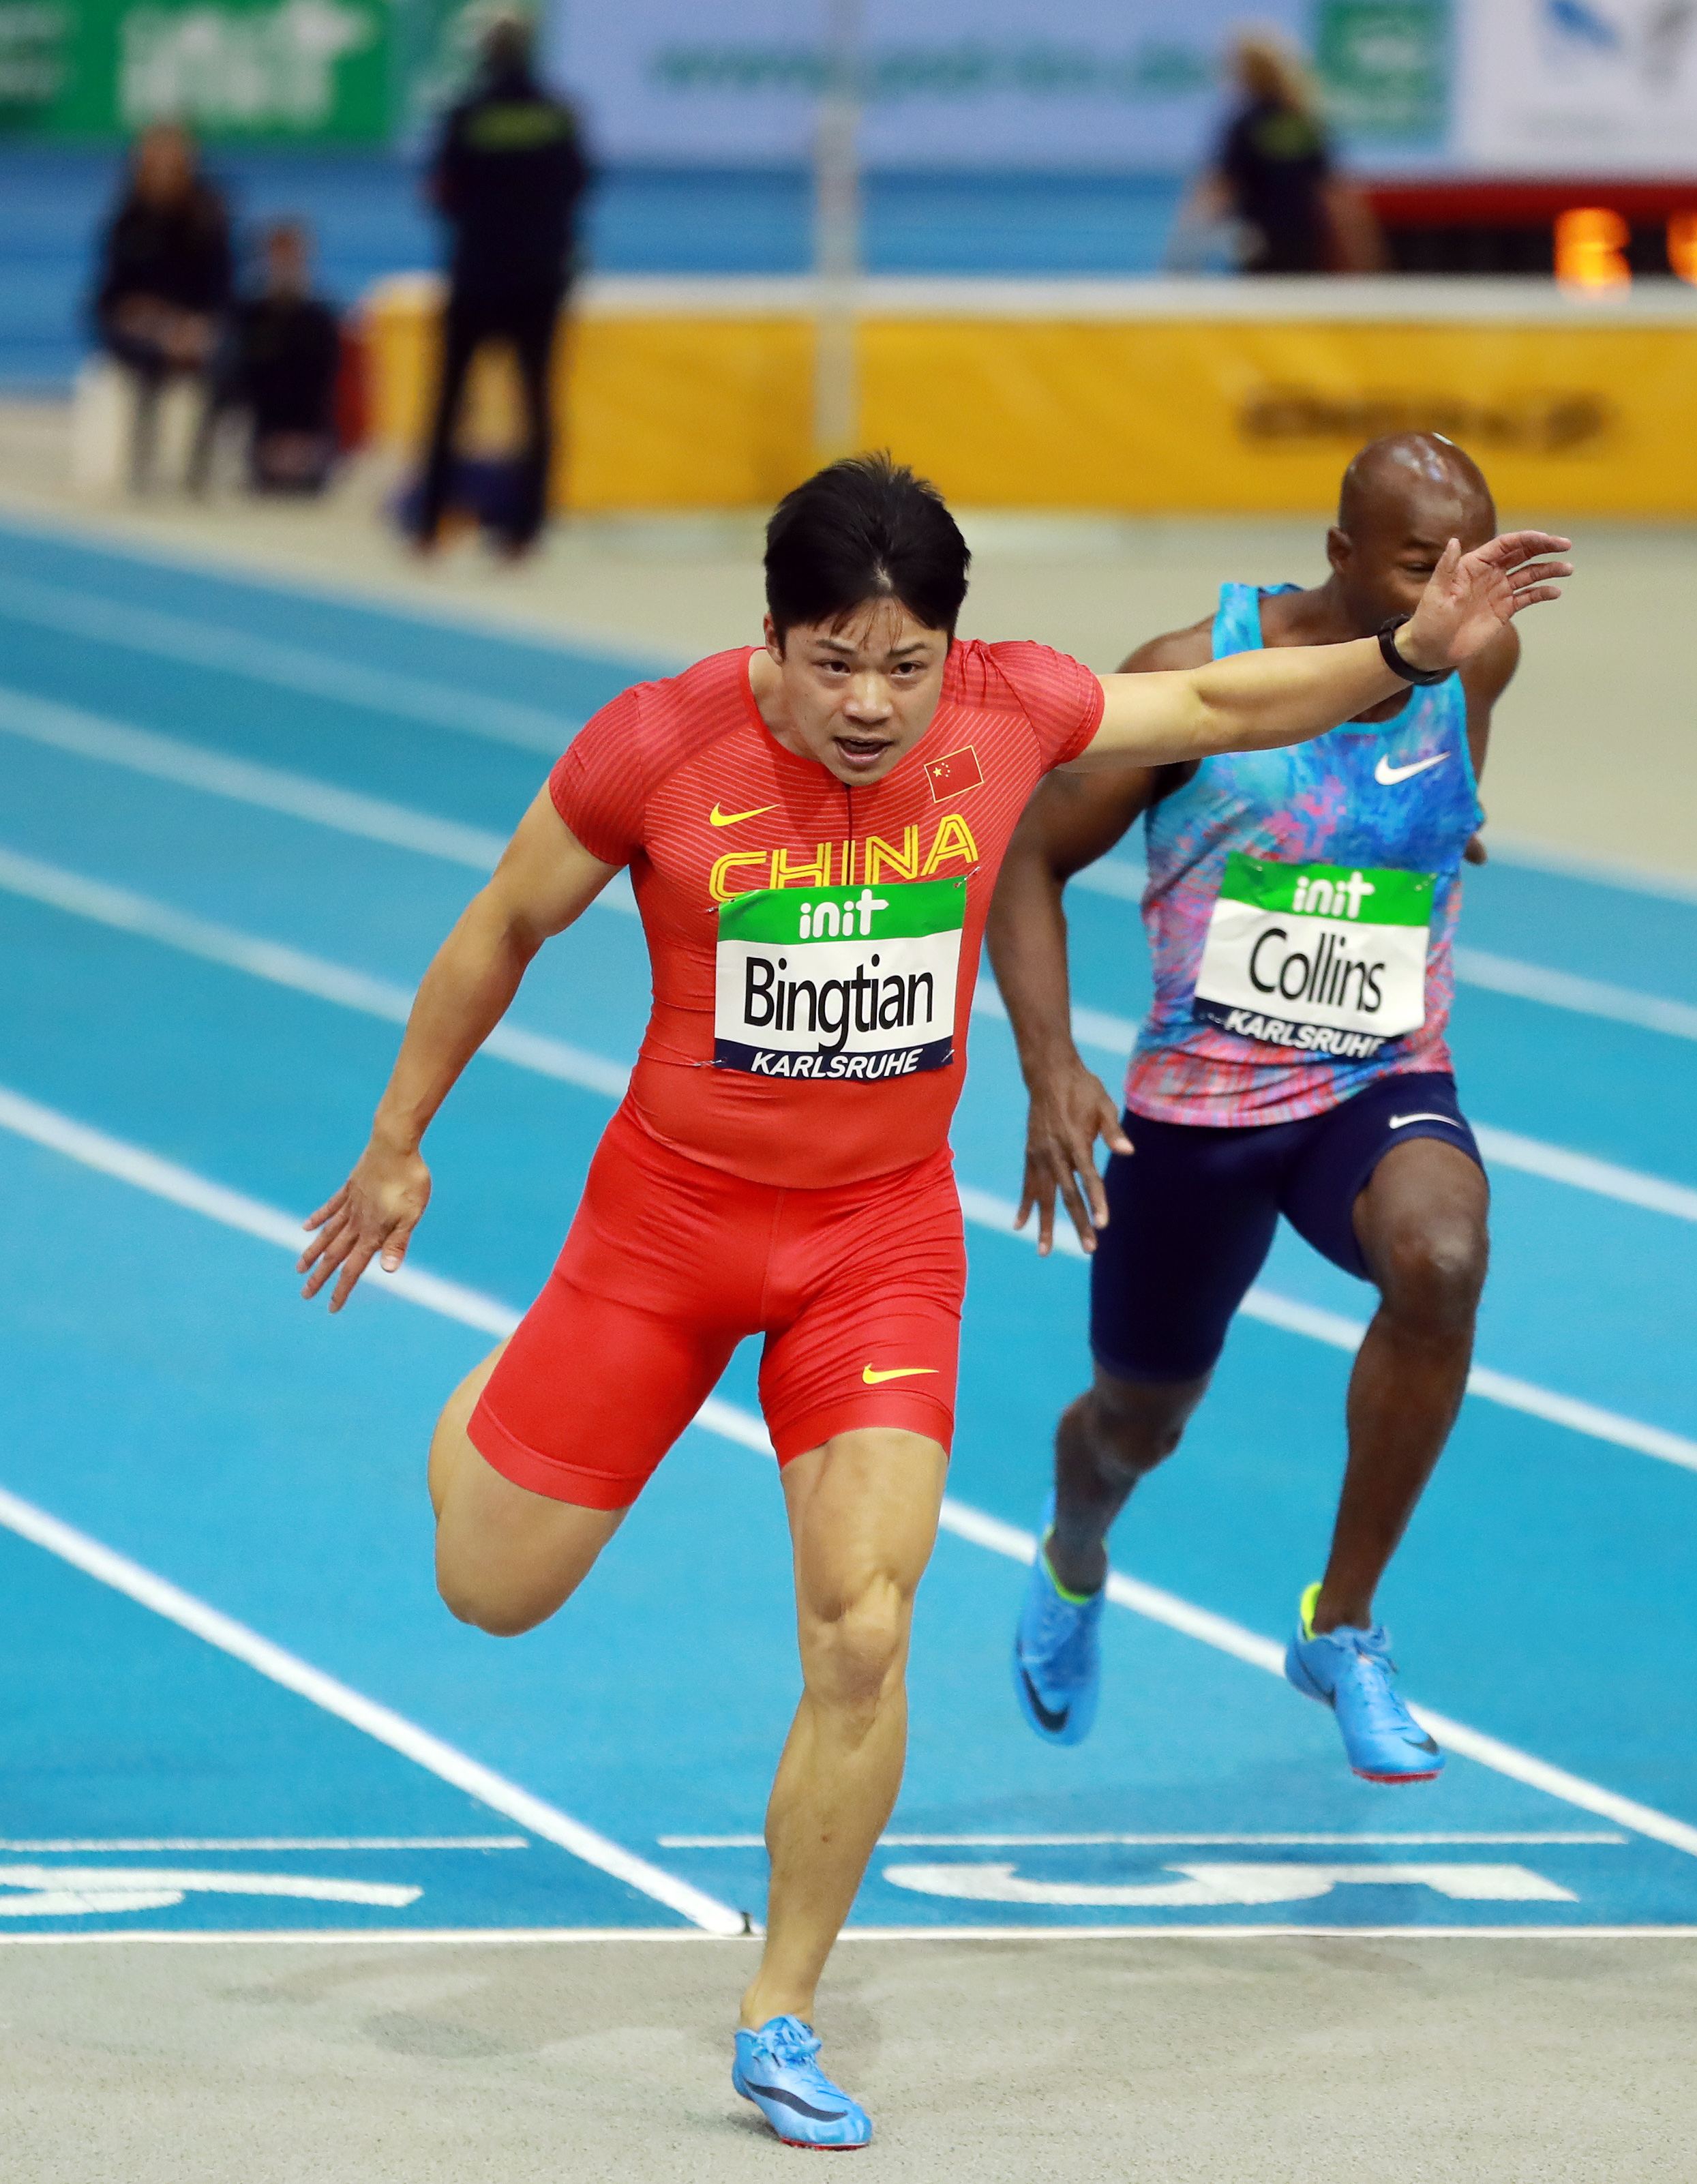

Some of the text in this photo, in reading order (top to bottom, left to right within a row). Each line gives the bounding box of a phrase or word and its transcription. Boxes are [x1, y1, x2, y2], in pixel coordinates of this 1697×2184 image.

[709, 813, 979, 902] CHINA
[799, 888, 889, 939] init
[1292, 871, 1375, 918] init
[744, 954, 933, 1053] Bingtian
[1249, 928, 1385, 1013] Collins
[751, 1048, 923, 1079] KARLSRUHE
